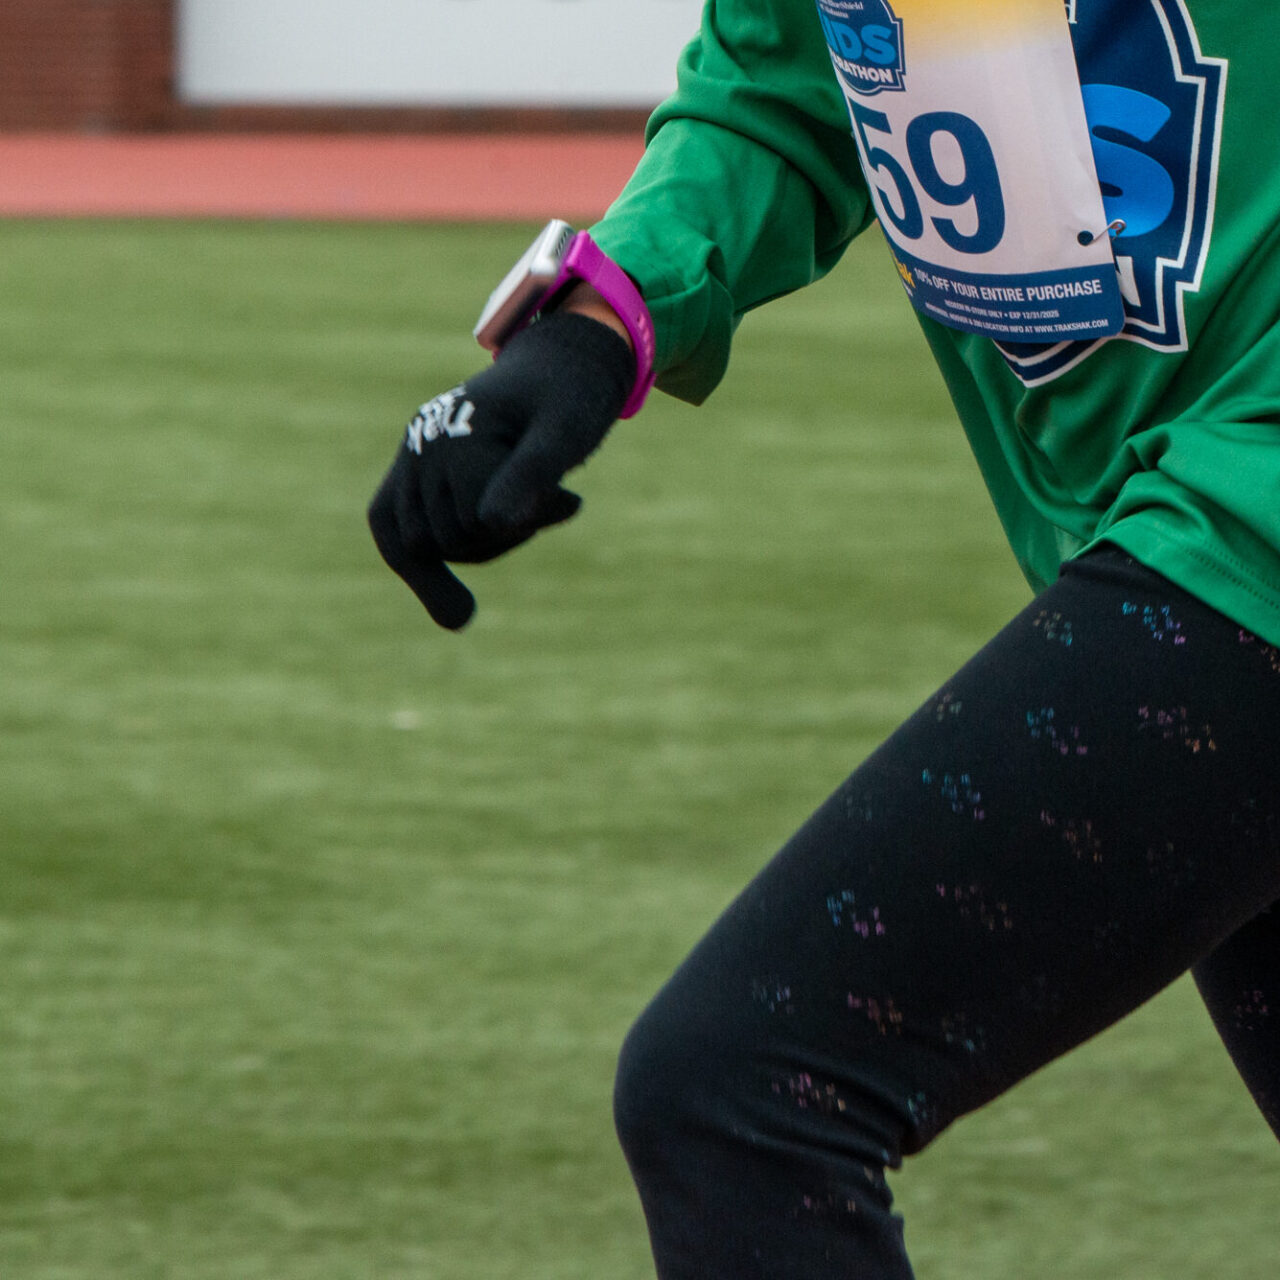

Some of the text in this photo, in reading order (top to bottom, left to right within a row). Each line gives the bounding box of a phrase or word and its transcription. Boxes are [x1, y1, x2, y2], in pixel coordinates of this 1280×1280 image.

[818, 13, 896, 65] IDS
[847, 96, 1005, 254] 59
[932, 275, 950, 292] OFF
[950, 280, 980, 299] YOUR
[980, 286, 1025, 302] ENTIRE
[1026, 279, 1103, 301] PURCHASE
[987, 309, 1003, 319] ONLY
[1009, 311, 1021, 320] EXP
[1009, 324, 1024, 333] INFO
[1024, 324, 1034, 333] AT
[1034, 318, 1109, 334] WWW.TRAKSHAK.COM
